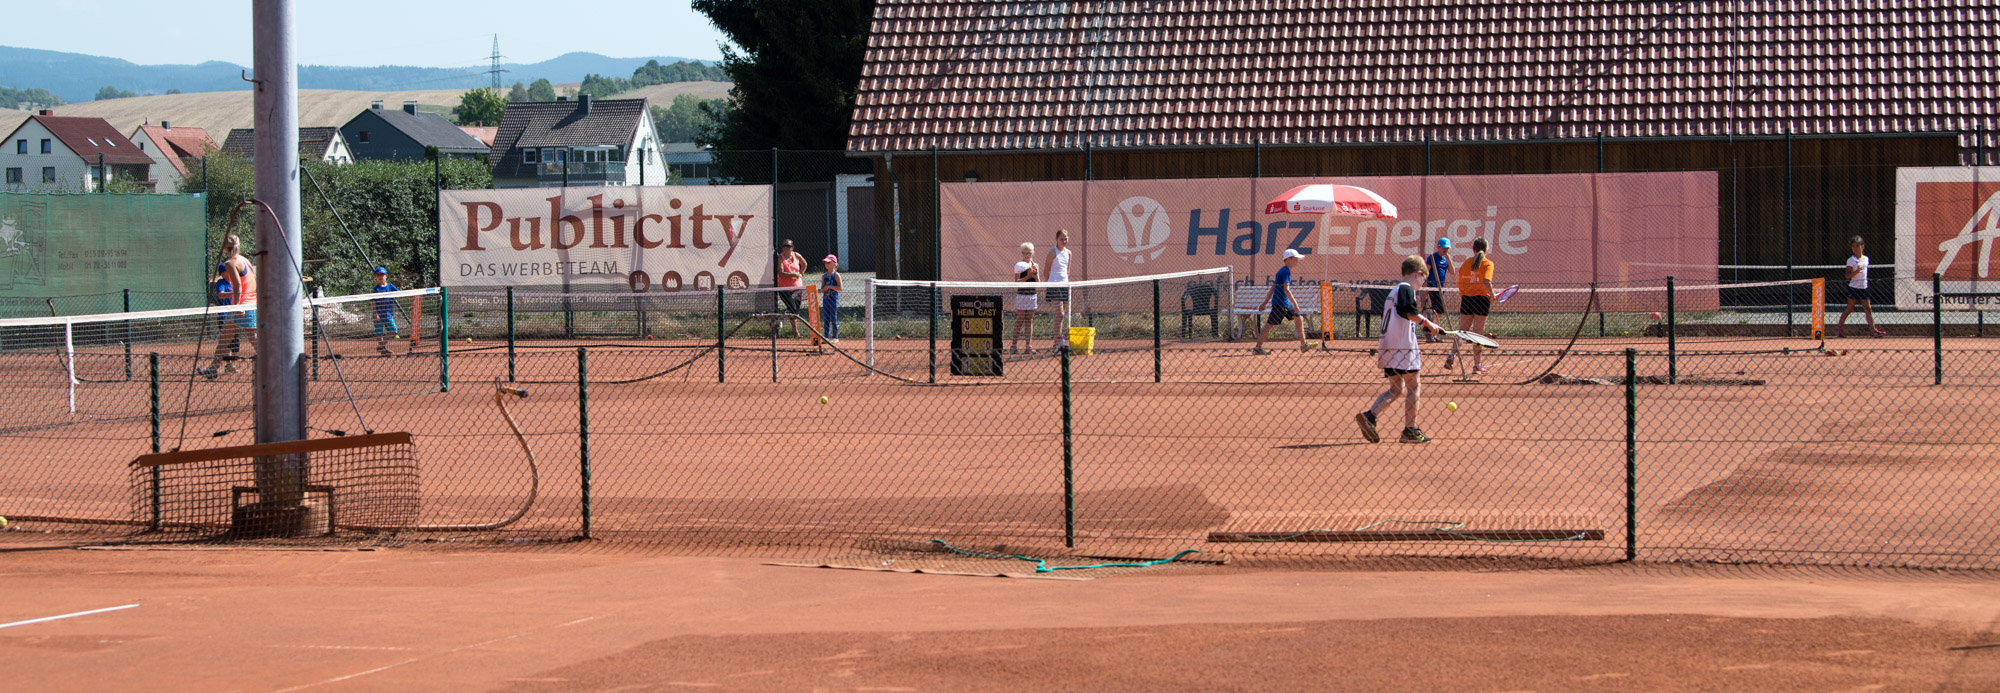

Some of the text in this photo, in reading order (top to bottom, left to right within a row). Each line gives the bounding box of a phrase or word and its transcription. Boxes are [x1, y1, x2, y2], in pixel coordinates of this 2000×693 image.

[459, 193, 755, 268] Publicity
[1186, 205, 1532, 267] HarzEnergie
[460, 260, 619, 277] DAS WERBETEAM
[957, 308, 997, 317] HEIM GAST
